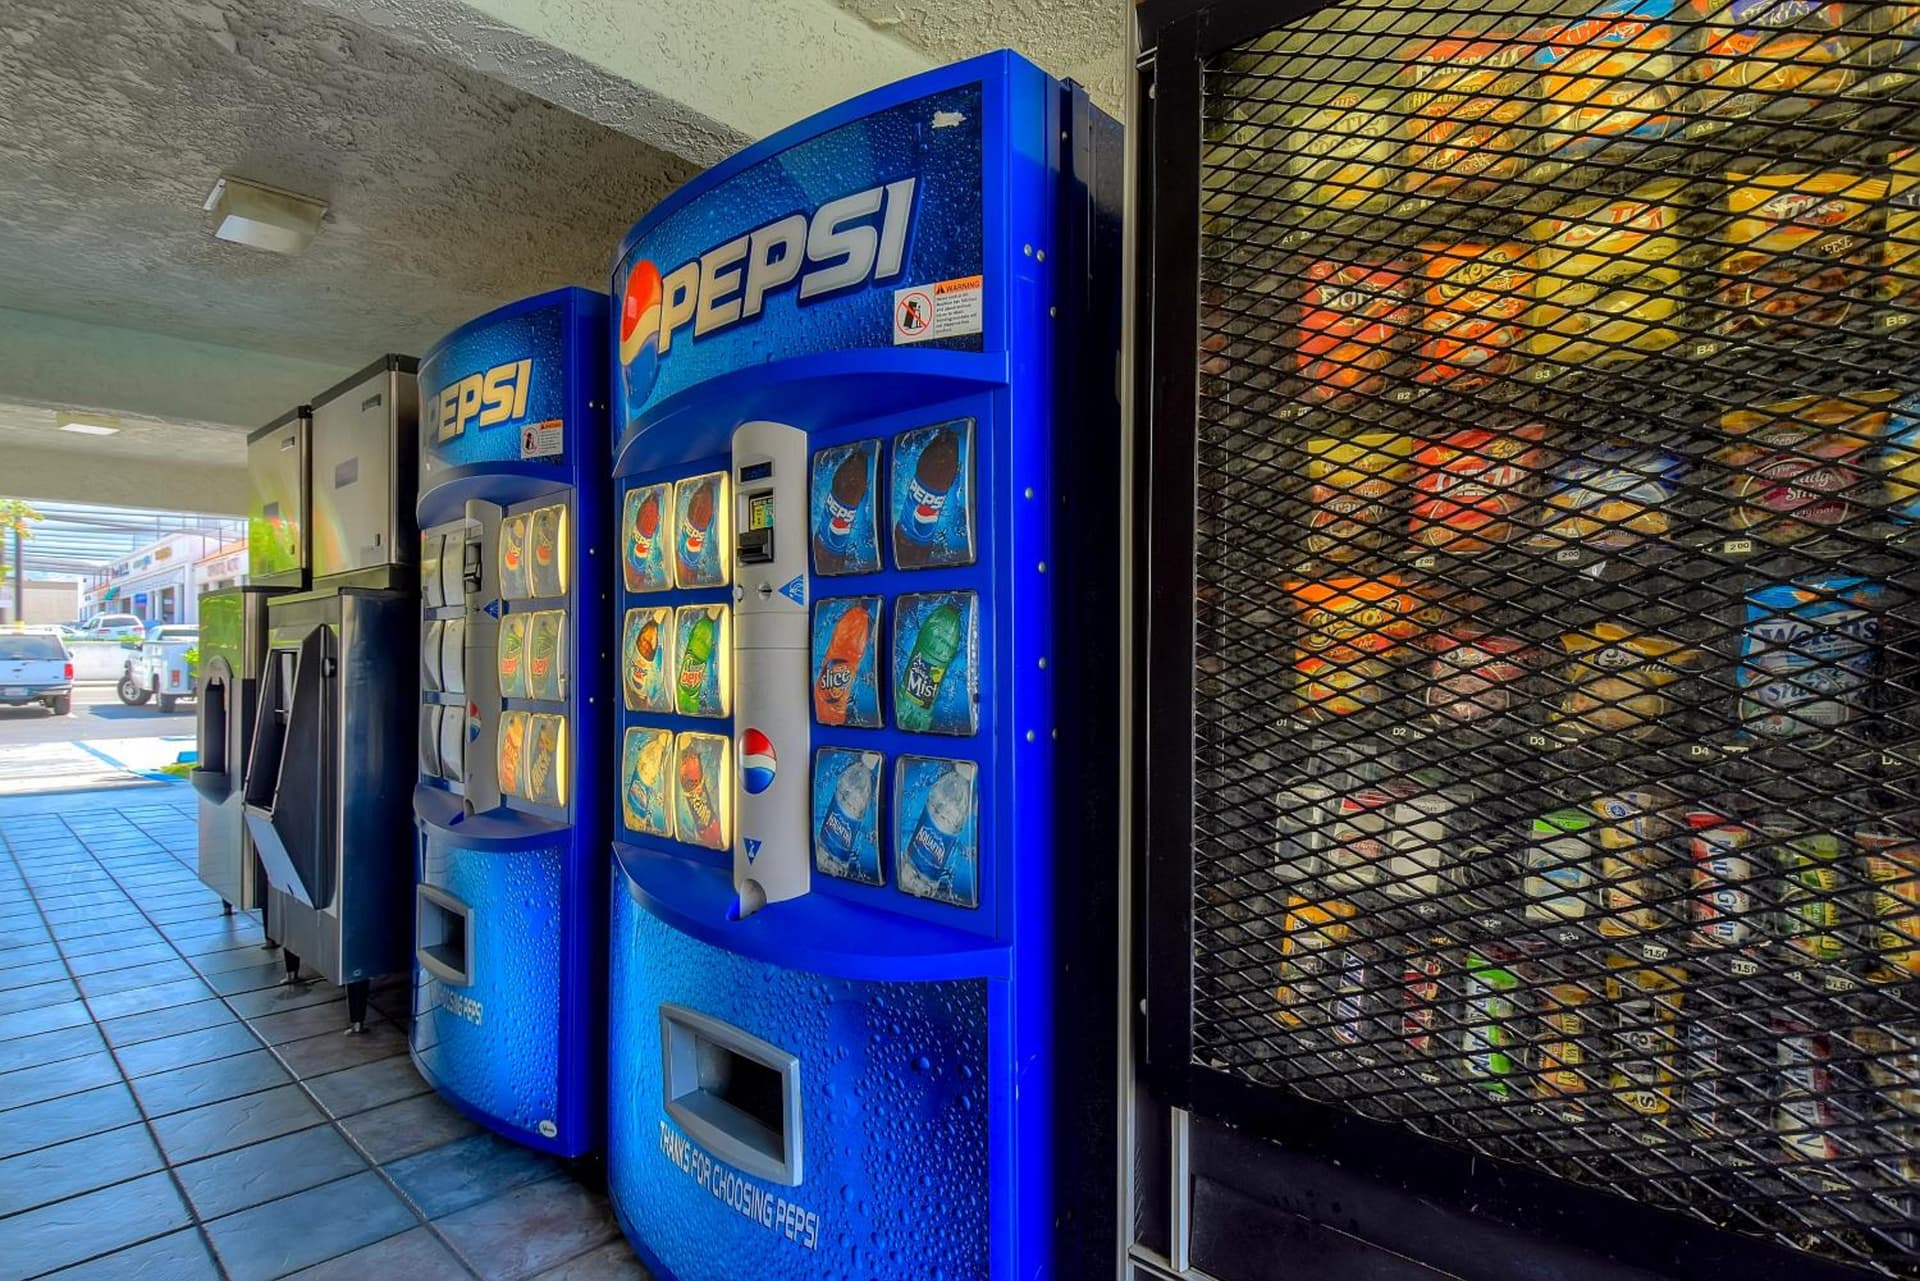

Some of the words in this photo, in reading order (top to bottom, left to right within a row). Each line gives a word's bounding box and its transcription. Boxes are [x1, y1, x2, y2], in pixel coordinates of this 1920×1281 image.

[1882, 72, 1905, 87] A5
[1695, 122, 1713, 134] A4
[1399, 202, 1413, 214] A2
[1281, 234, 1293, 244] A1
[656, 177, 918, 355] PEPSI
[946, 280, 981, 293] WARNING
[1886, 316, 1907, 327] B5
[1697, 343, 1714, 355] B4
[1534, 369, 1550, 380] B3
[428, 358, 532, 444] PEPSI
[1397, 391, 1410, 401] B2
[909, 479, 946, 509] PEPS
[827, 494, 856, 522] PEPS
[1392, 727, 1406, 736] D2
[1529, 736, 1545, 746] D3
[1691, 746, 1709, 755] D4
[1732, 961, 1758, 976] $1.50
[659, 1120, 690, 1173] THANKS
[690, 1150, 711, 1187] FOR
[711, 1170, 773, 1227] CHOOSING
[774, 1198, 820, 1251] PEPSI
